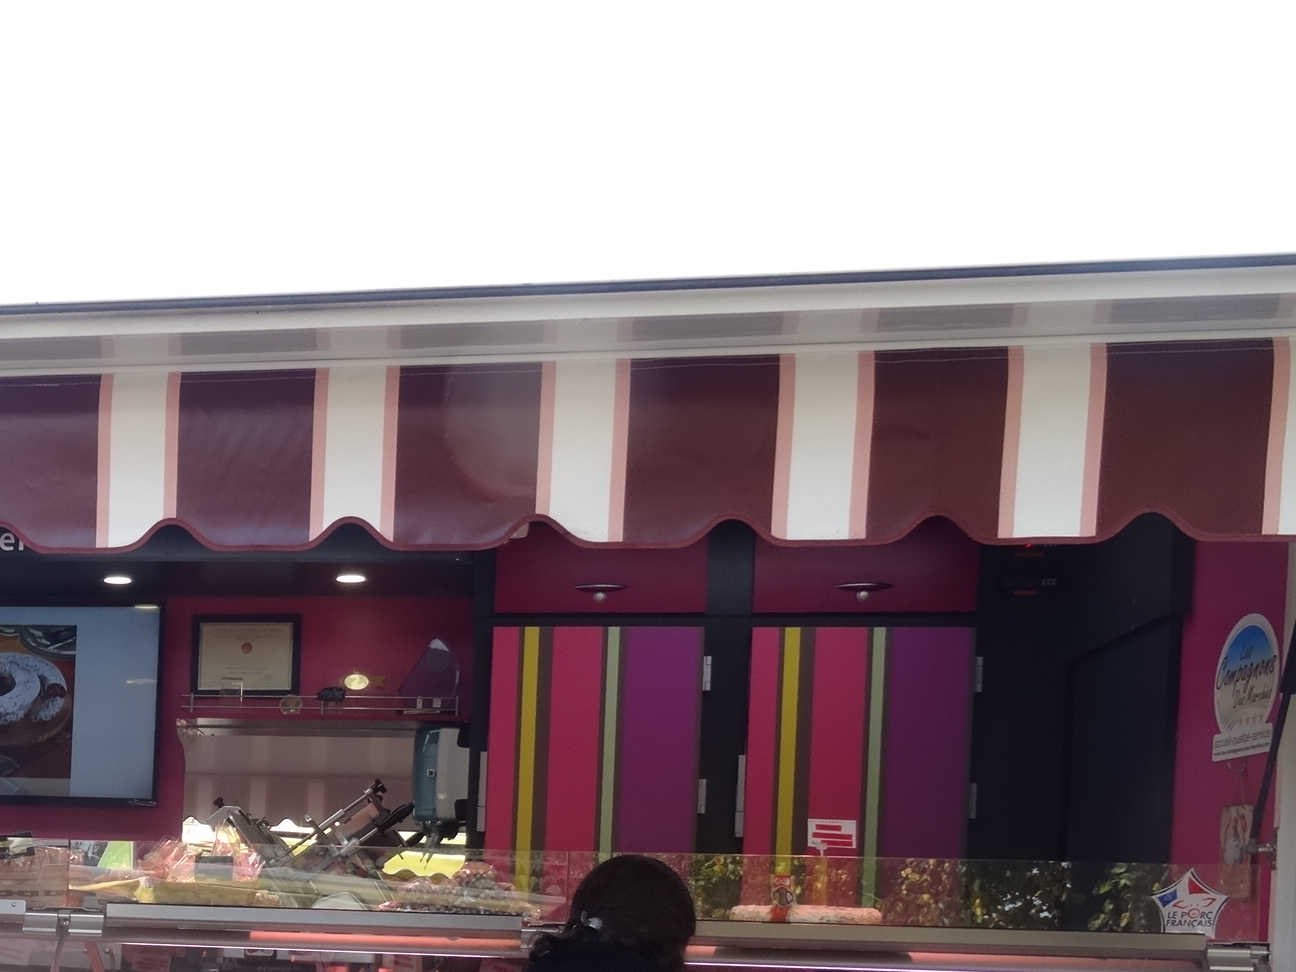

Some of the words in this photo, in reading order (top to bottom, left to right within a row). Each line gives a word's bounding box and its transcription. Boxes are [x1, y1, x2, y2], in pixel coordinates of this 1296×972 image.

[1216, 654, 1277, 697] Compagnons
[1167, 911, 1177, 920] LE
[1181, 908, 1214, 920] PORC
[1165, 919, 1213, 928] FRANÇAIS
